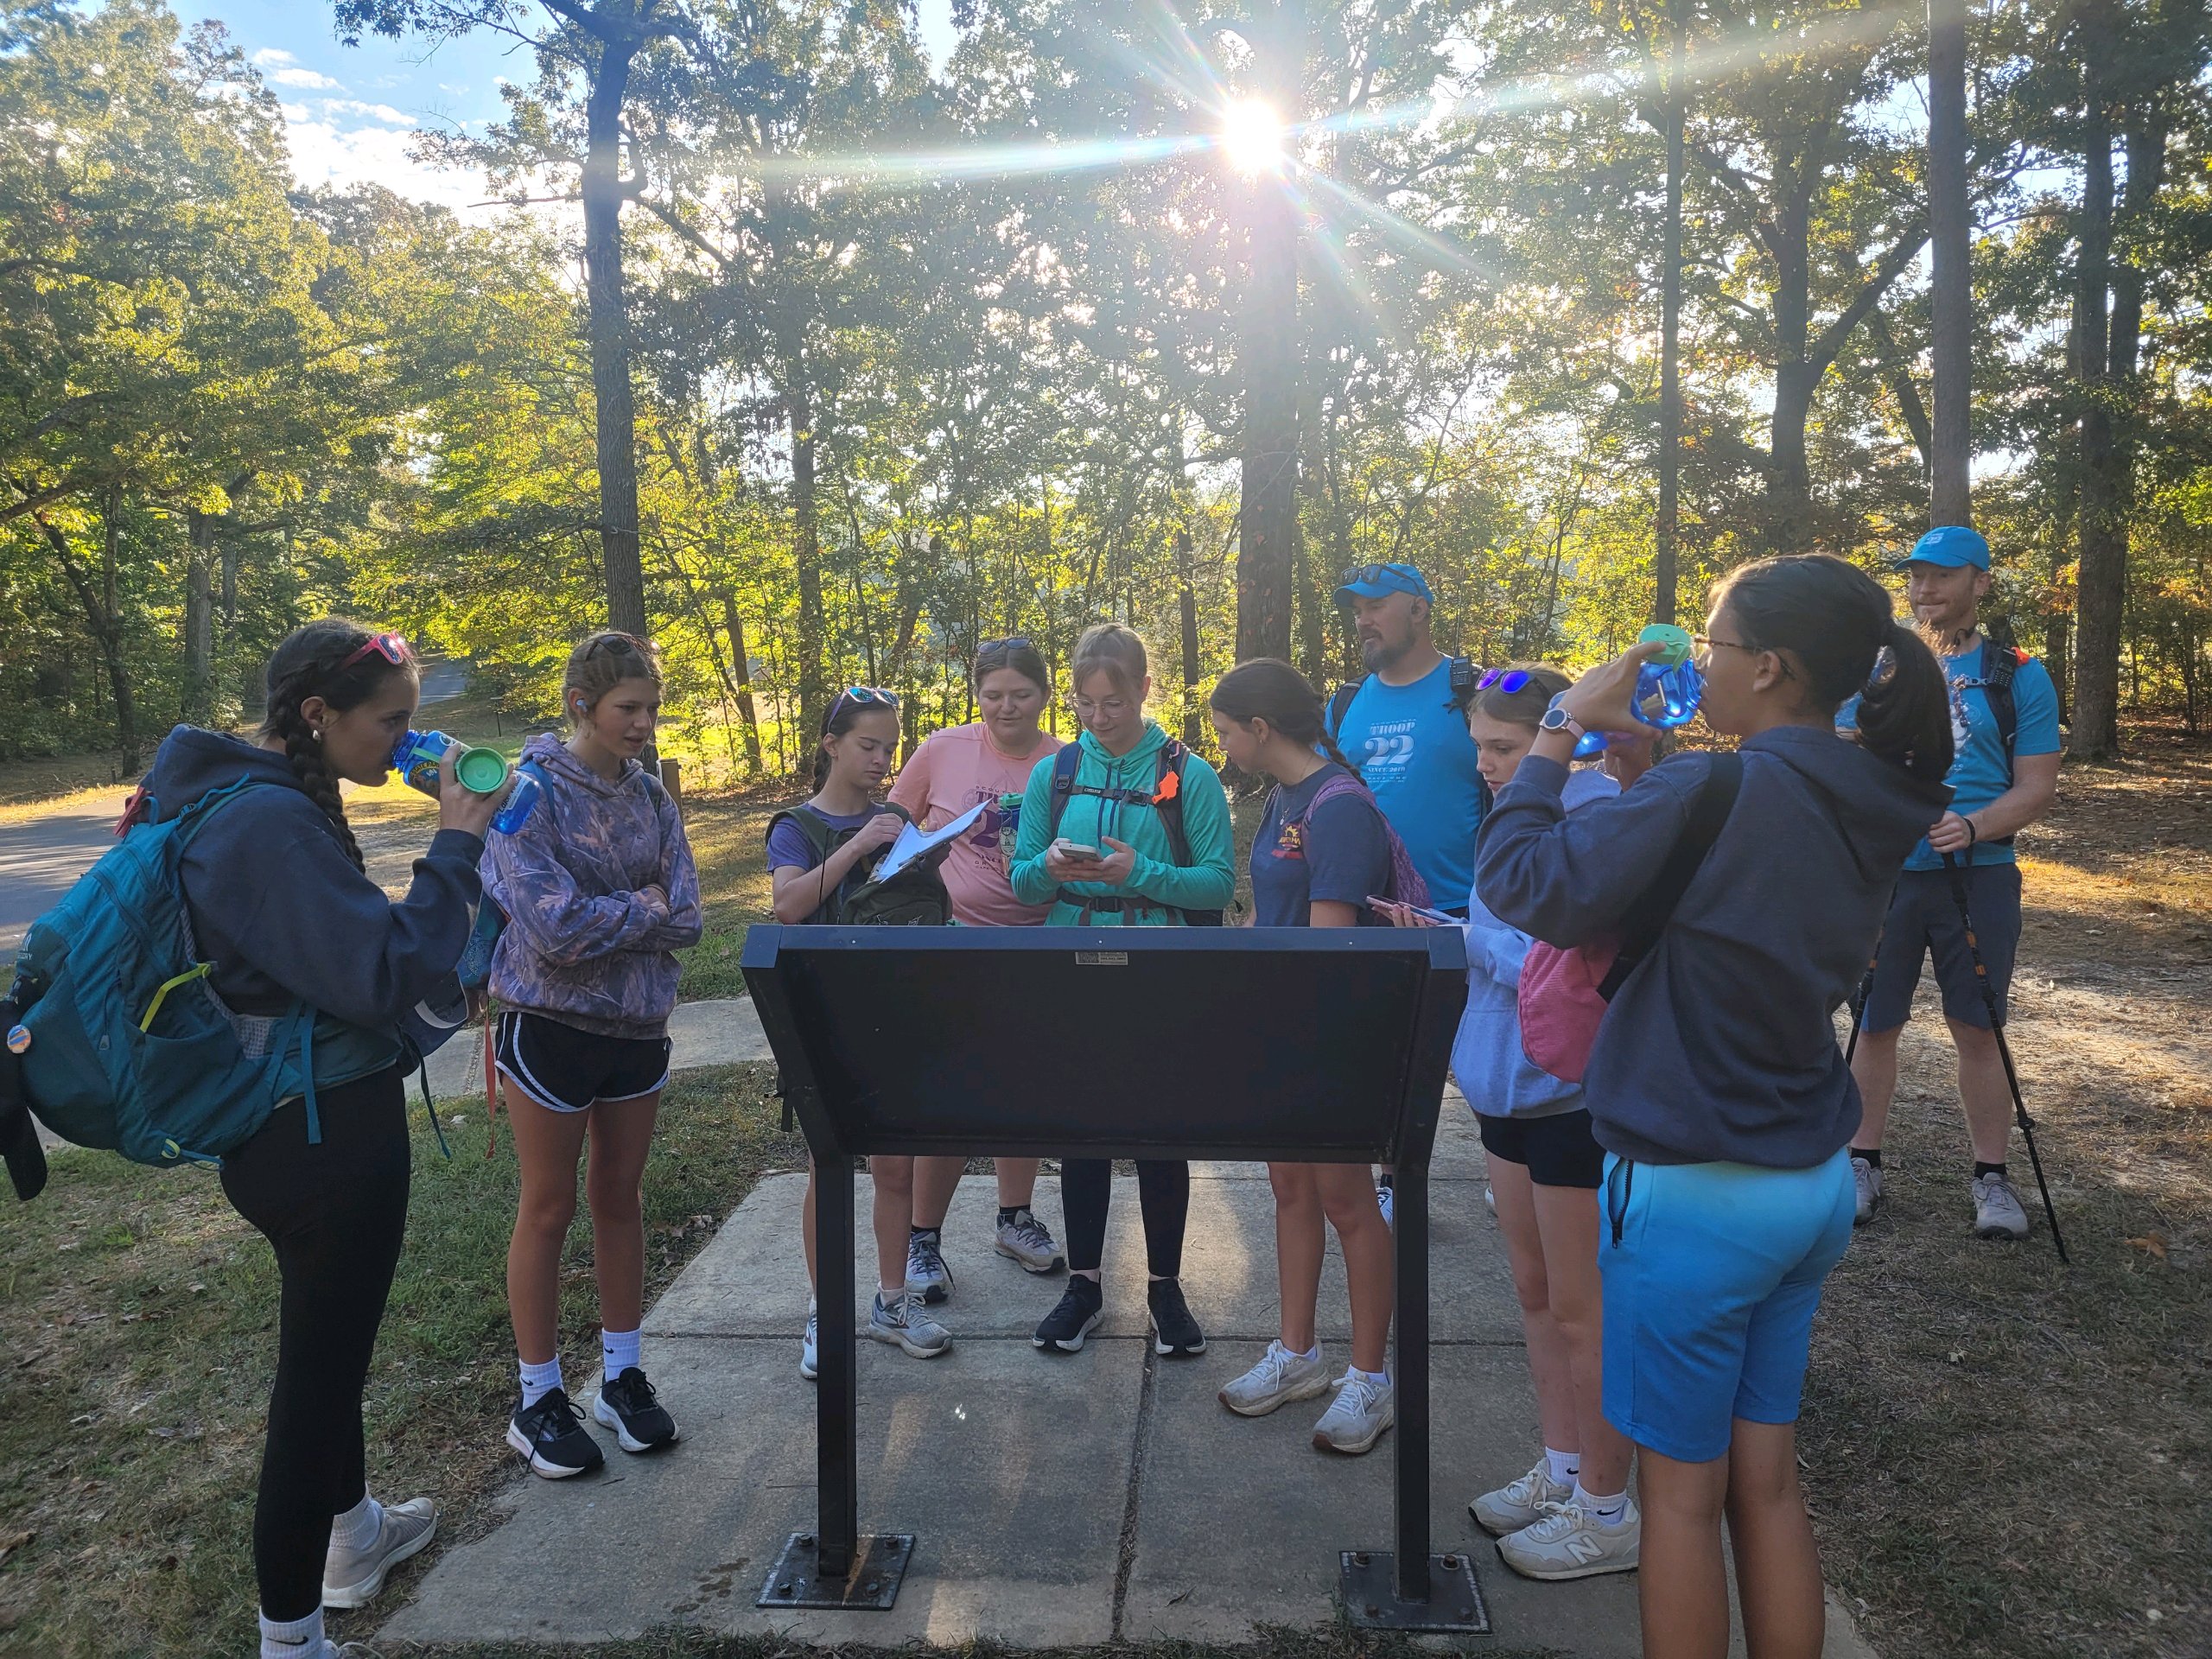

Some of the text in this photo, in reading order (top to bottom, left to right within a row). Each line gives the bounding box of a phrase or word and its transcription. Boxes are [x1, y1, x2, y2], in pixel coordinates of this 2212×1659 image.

[1370, 722, 1415, 735] TROOP
[1365, 735, 1414, 766] 22
[1565, 1534, 1604, 1565] N
